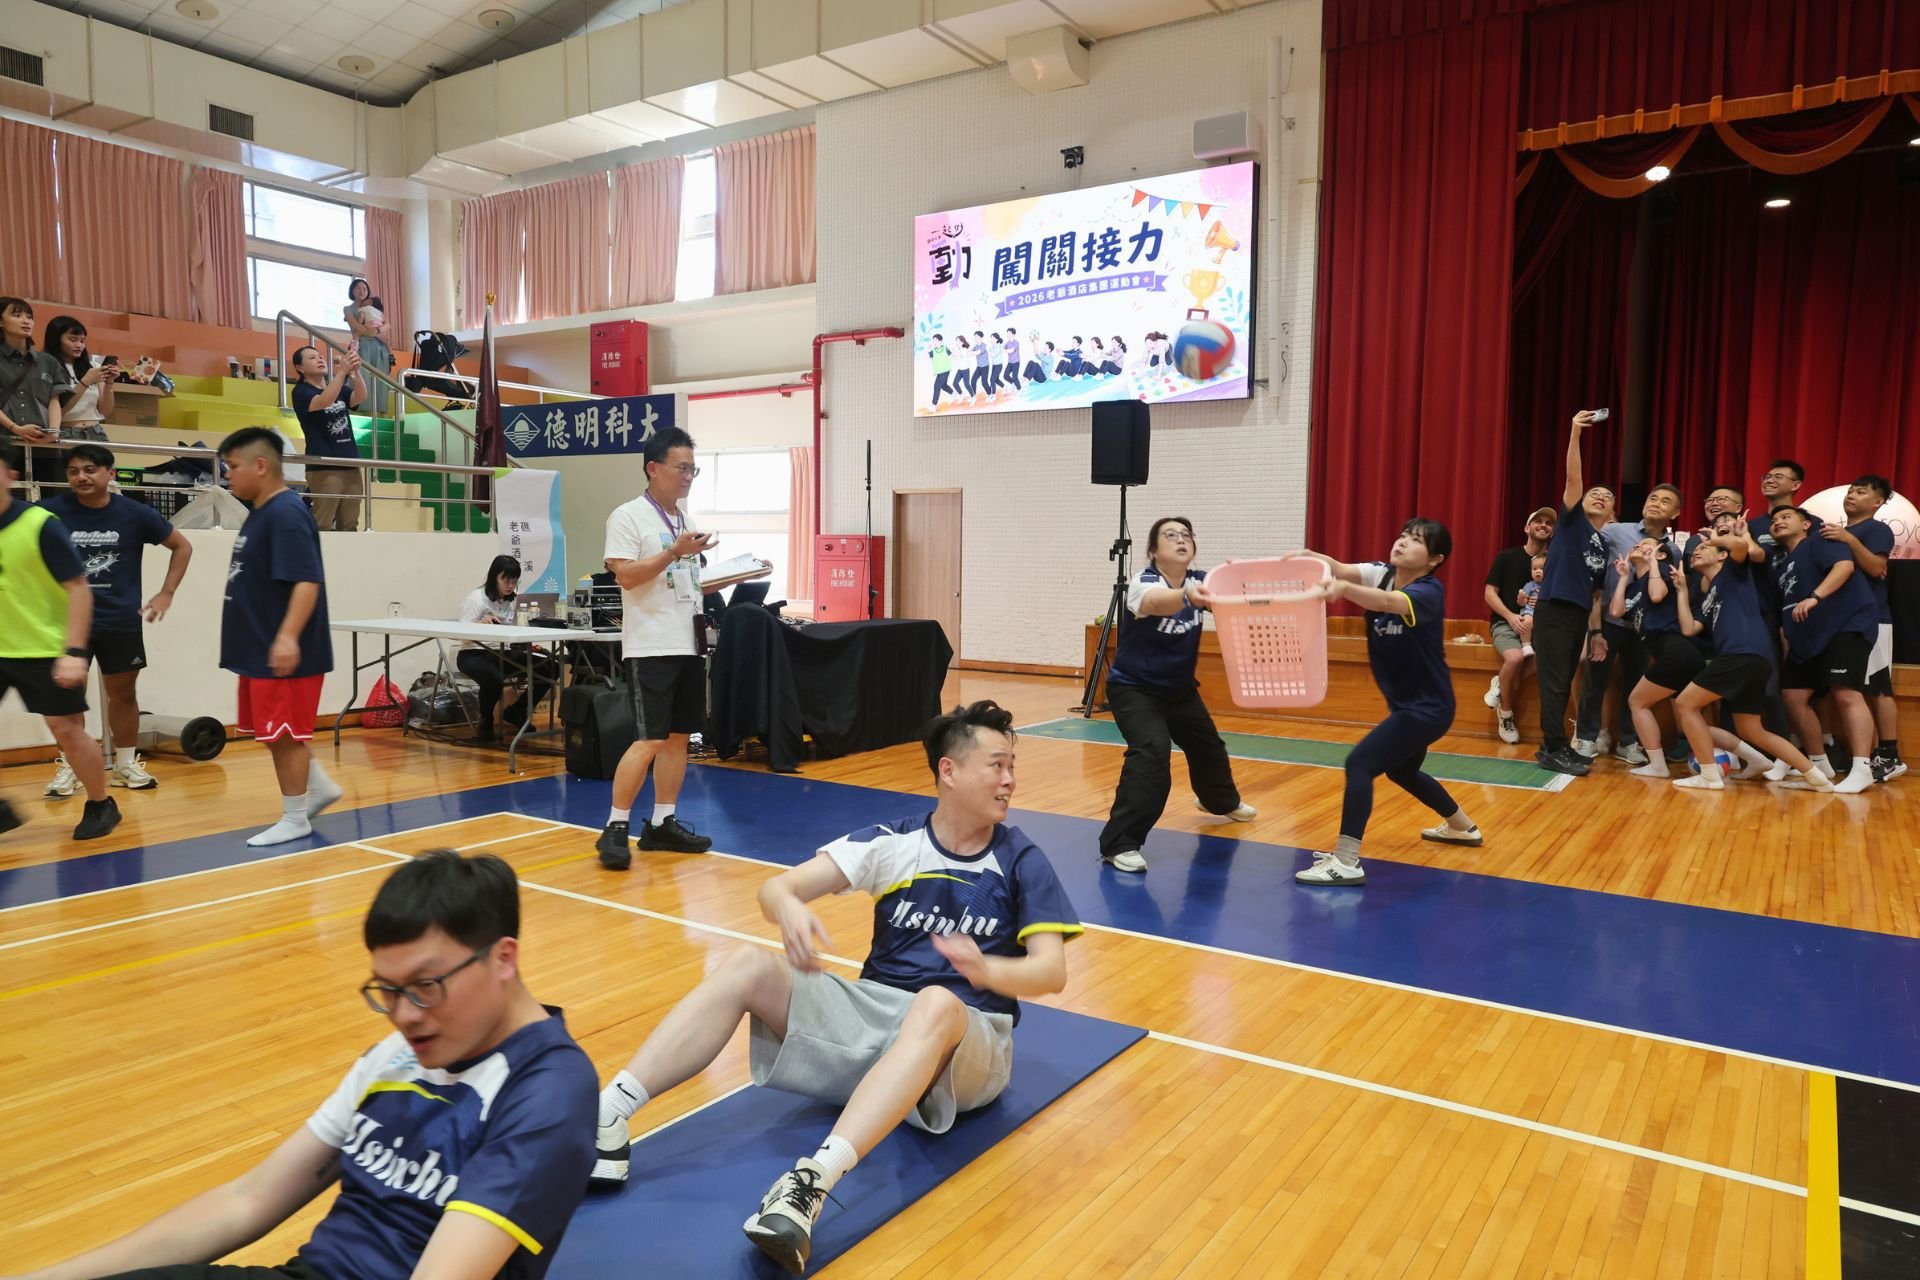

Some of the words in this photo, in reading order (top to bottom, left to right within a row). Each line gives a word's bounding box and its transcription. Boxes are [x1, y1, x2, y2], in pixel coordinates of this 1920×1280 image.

[992, 221, 1164, 291] 闖關接力
[543, 402, 660, 450] 德明科大
